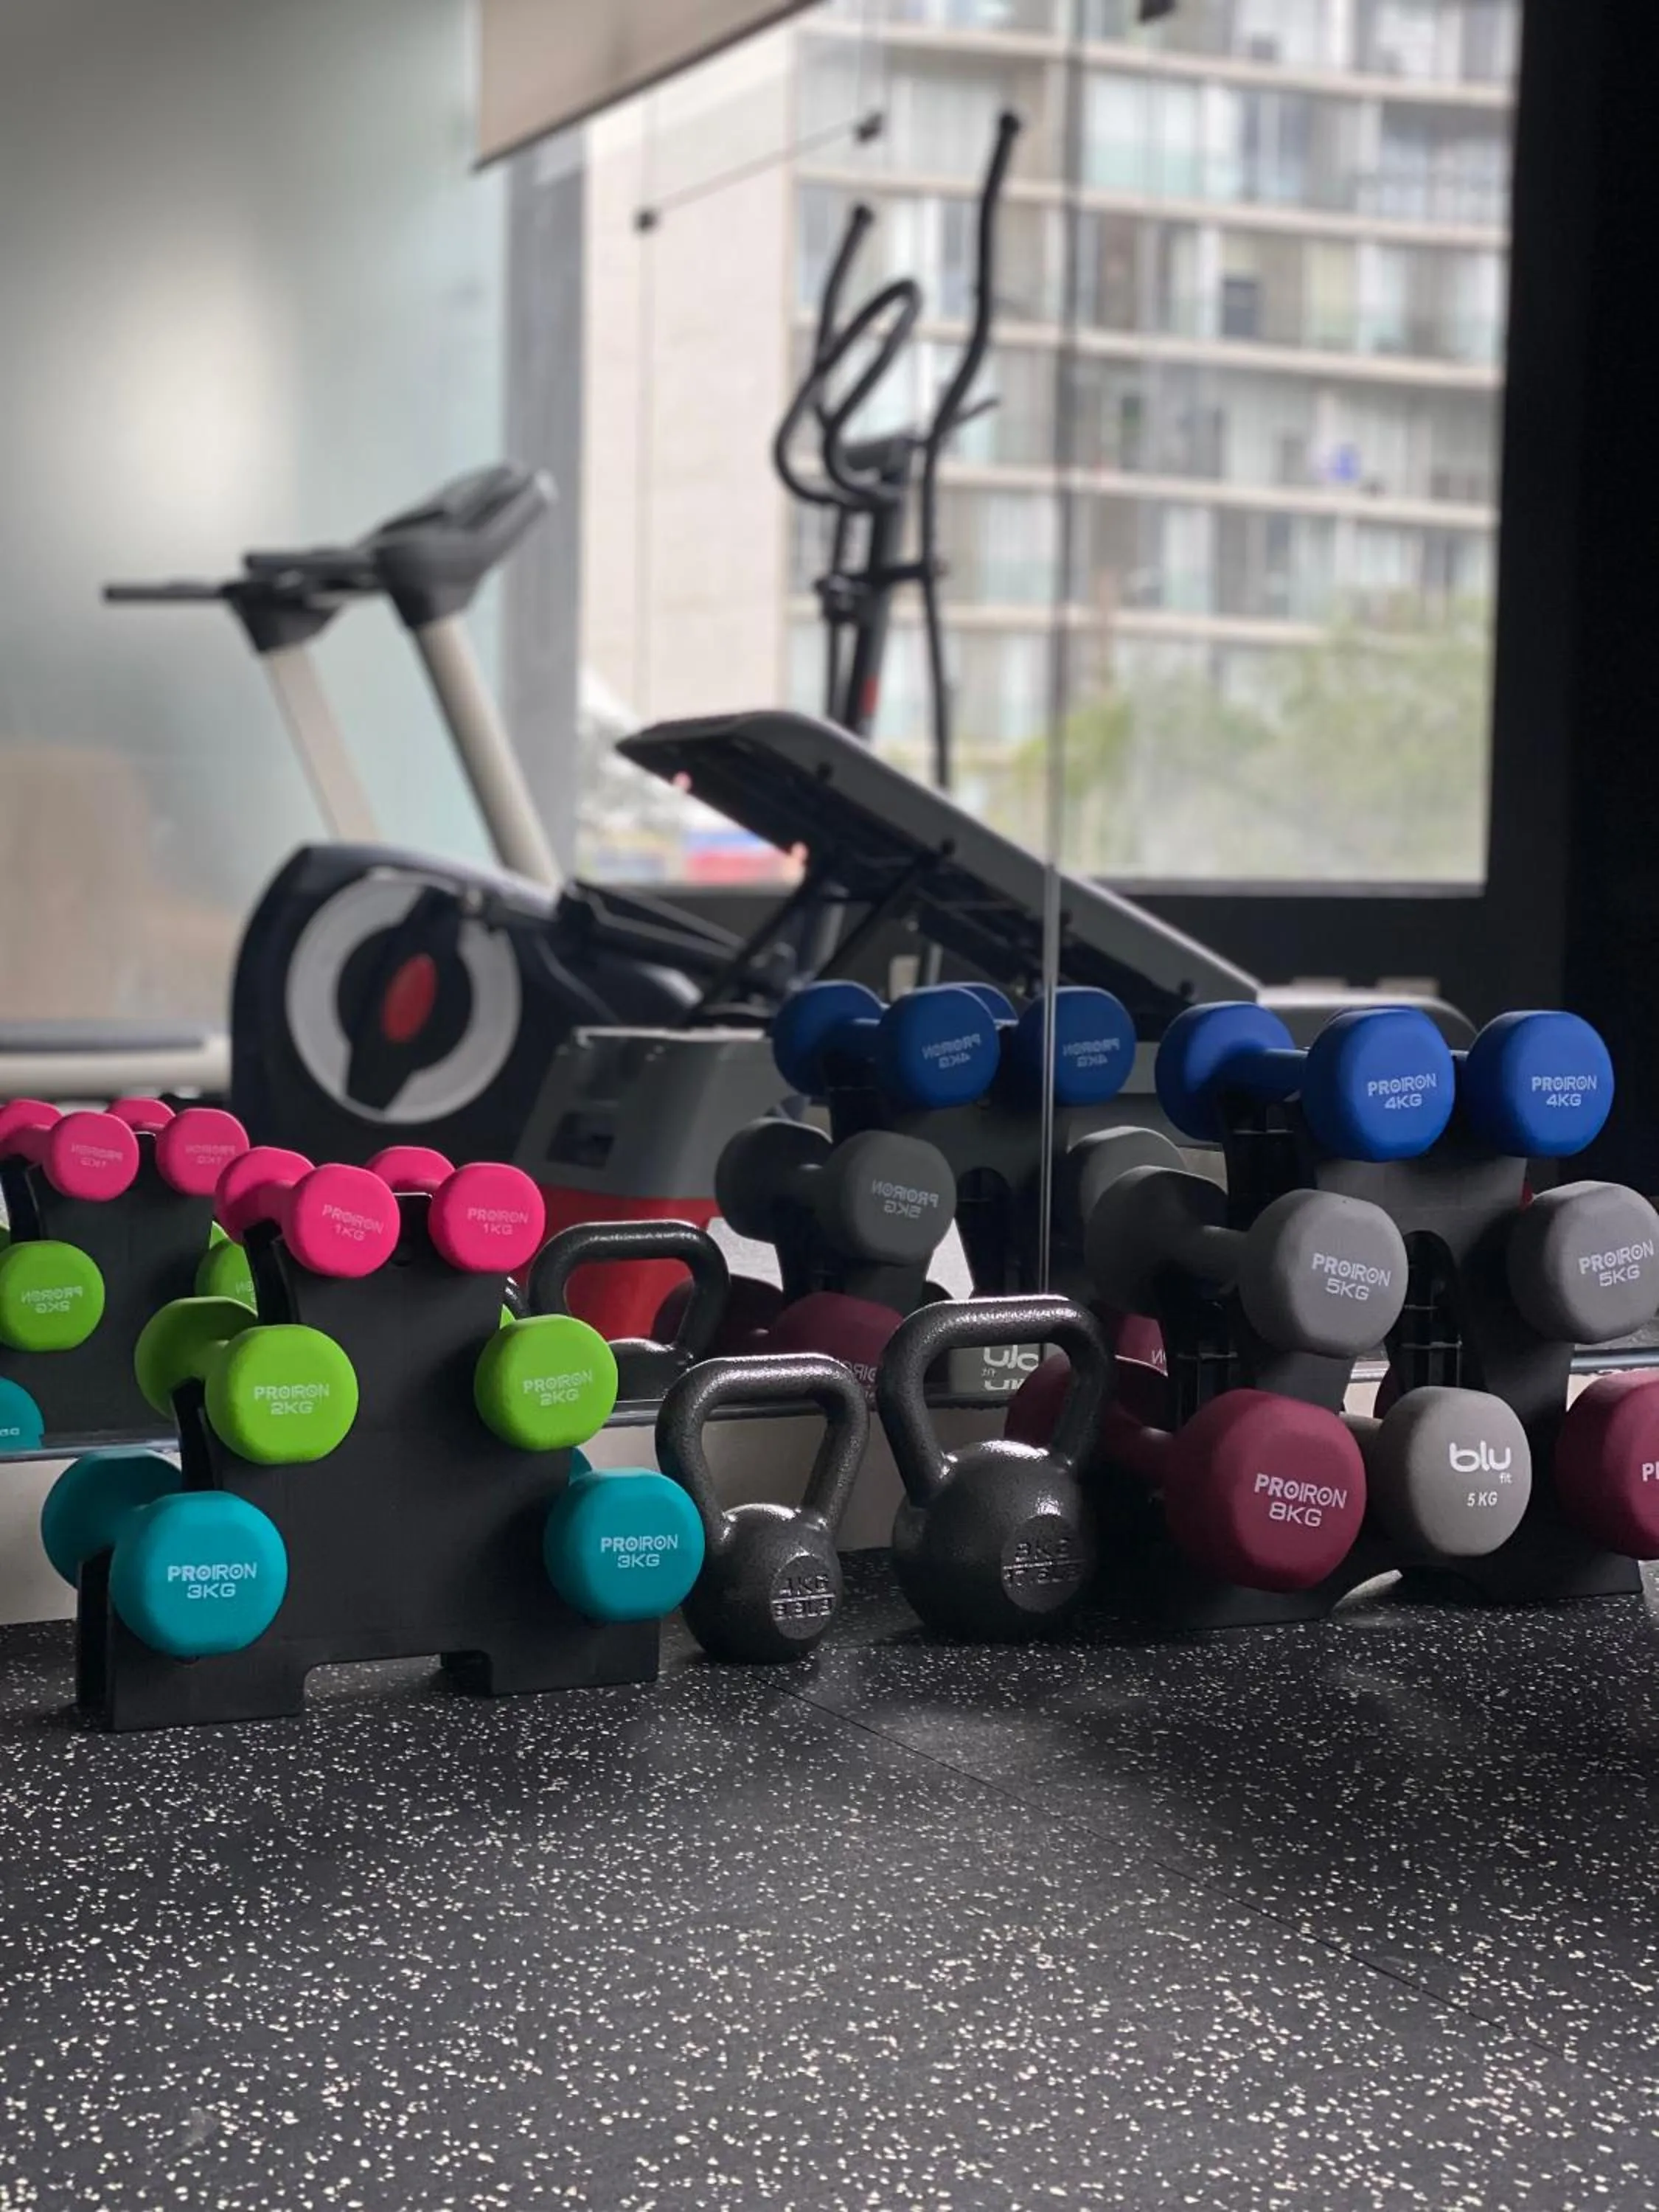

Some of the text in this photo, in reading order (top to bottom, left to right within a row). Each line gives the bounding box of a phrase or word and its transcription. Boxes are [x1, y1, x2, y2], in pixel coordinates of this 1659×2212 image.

[1368, 1073, 1437, 1096] PROIRON
[1531, 1074, 1597, 1092] PROIRON
[1385, 1093, 1422, 1109] 4KG
[1546, 1093, 1582, 1107] 4KG
[322, 1204, 383, 1234] PROIRON
[467, 1207, 529, 1224] PROIRON
[335, 1224, 366, 1242] 1KG
[483, 1224, 513, 1236] 1KG
[1579, 1239, 1655, 1274] PROIRON
[1312, 1252, 1391, 1287] PROIRON
[1599, 1265, 1641, 1287] 5KG
[1326, 1278, 1369, 1301] 5KG
[524, 1369, 593, 1394] PROIRON
[254, 1383, 330, 1400] PROIRON
[539, 1388, 580, 1406] 2KG
[270, 1401, 313, 1415] 2KG
[1449, 1440, 1512, 1472] blu
[1499, 1472, 1512, 1484] fit
[1254, 1472, 1347, 1509] PROIRON
[1268, 1502, 1322, 1527] 8KG
[600, 1534, 678, 1553] PROIRON
[617, 1553, 661, 1568] 3KG
[167, 1562, 257, 1582] PROIRON
[187, 1583, 237, 1599] 3KG
